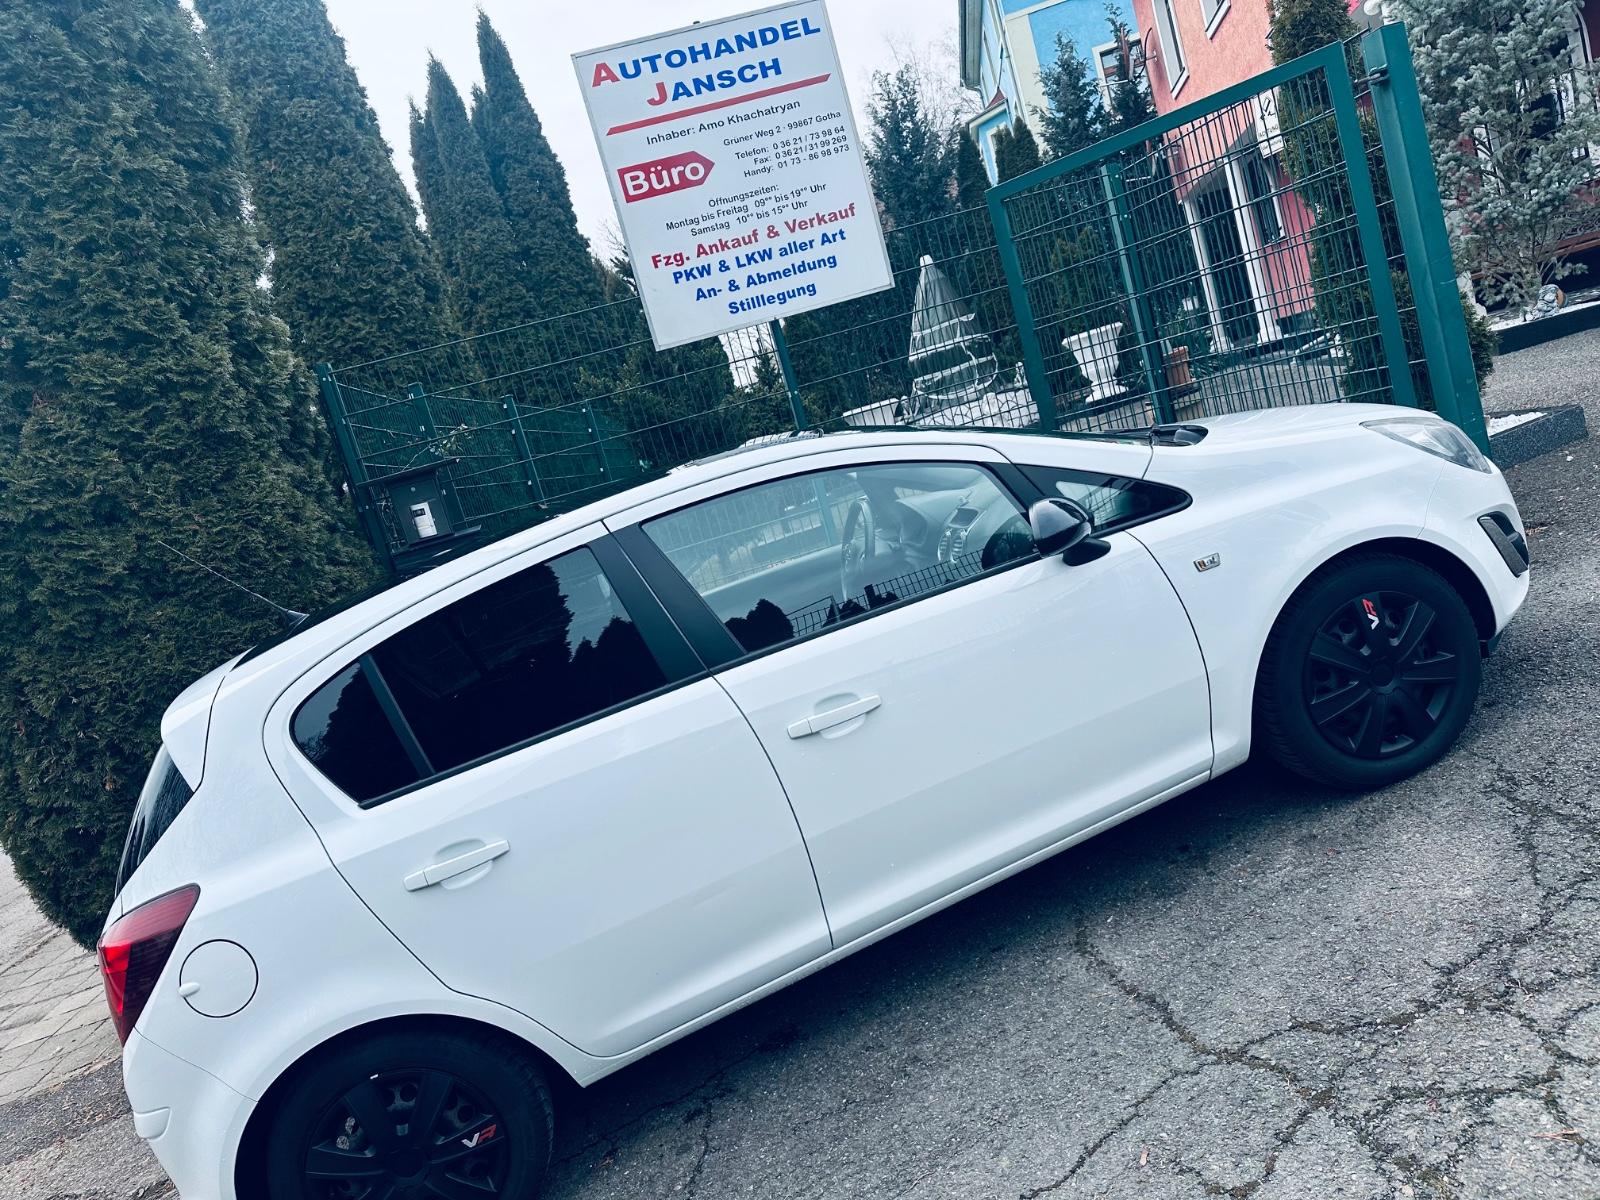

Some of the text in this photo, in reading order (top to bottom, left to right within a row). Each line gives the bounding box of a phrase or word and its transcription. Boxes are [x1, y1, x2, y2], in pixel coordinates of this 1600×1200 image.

[592, 17, 821, 88] AUTOHANDEL
[647, 57, 782, 106] JANSCH
[646, 101, 801, 145] Inhaber: Amo Khachatryan
[754, 129, 775, 138] Weg
[775, 125, 782, 134] 2
[787, 117, 813, 130] 99867
[815, 112, 841, 123] Gotha
[624, 162, 705, 196] Büro
[666, 217, 700, 231] Montag
[701, 212, 715, 222] bis
[716, 204, 749, 218] Freitag
[774, 194, 790, 203] bis
[809, 184, 826, 193] Uhr
[690, 221, 731, 237] Samstag
[755, 210, 770, 220] bis
[791, 200, 808, 210] Uhr
[651, 202, 855, 269] Fzg. Ankauf & Verkauf
[672, 228, 847, 284] PKW & LKW aller Art
[696, 255, 837, 302] An- & Abmeldung
[728, 283, 817, 315] Stilllegung
